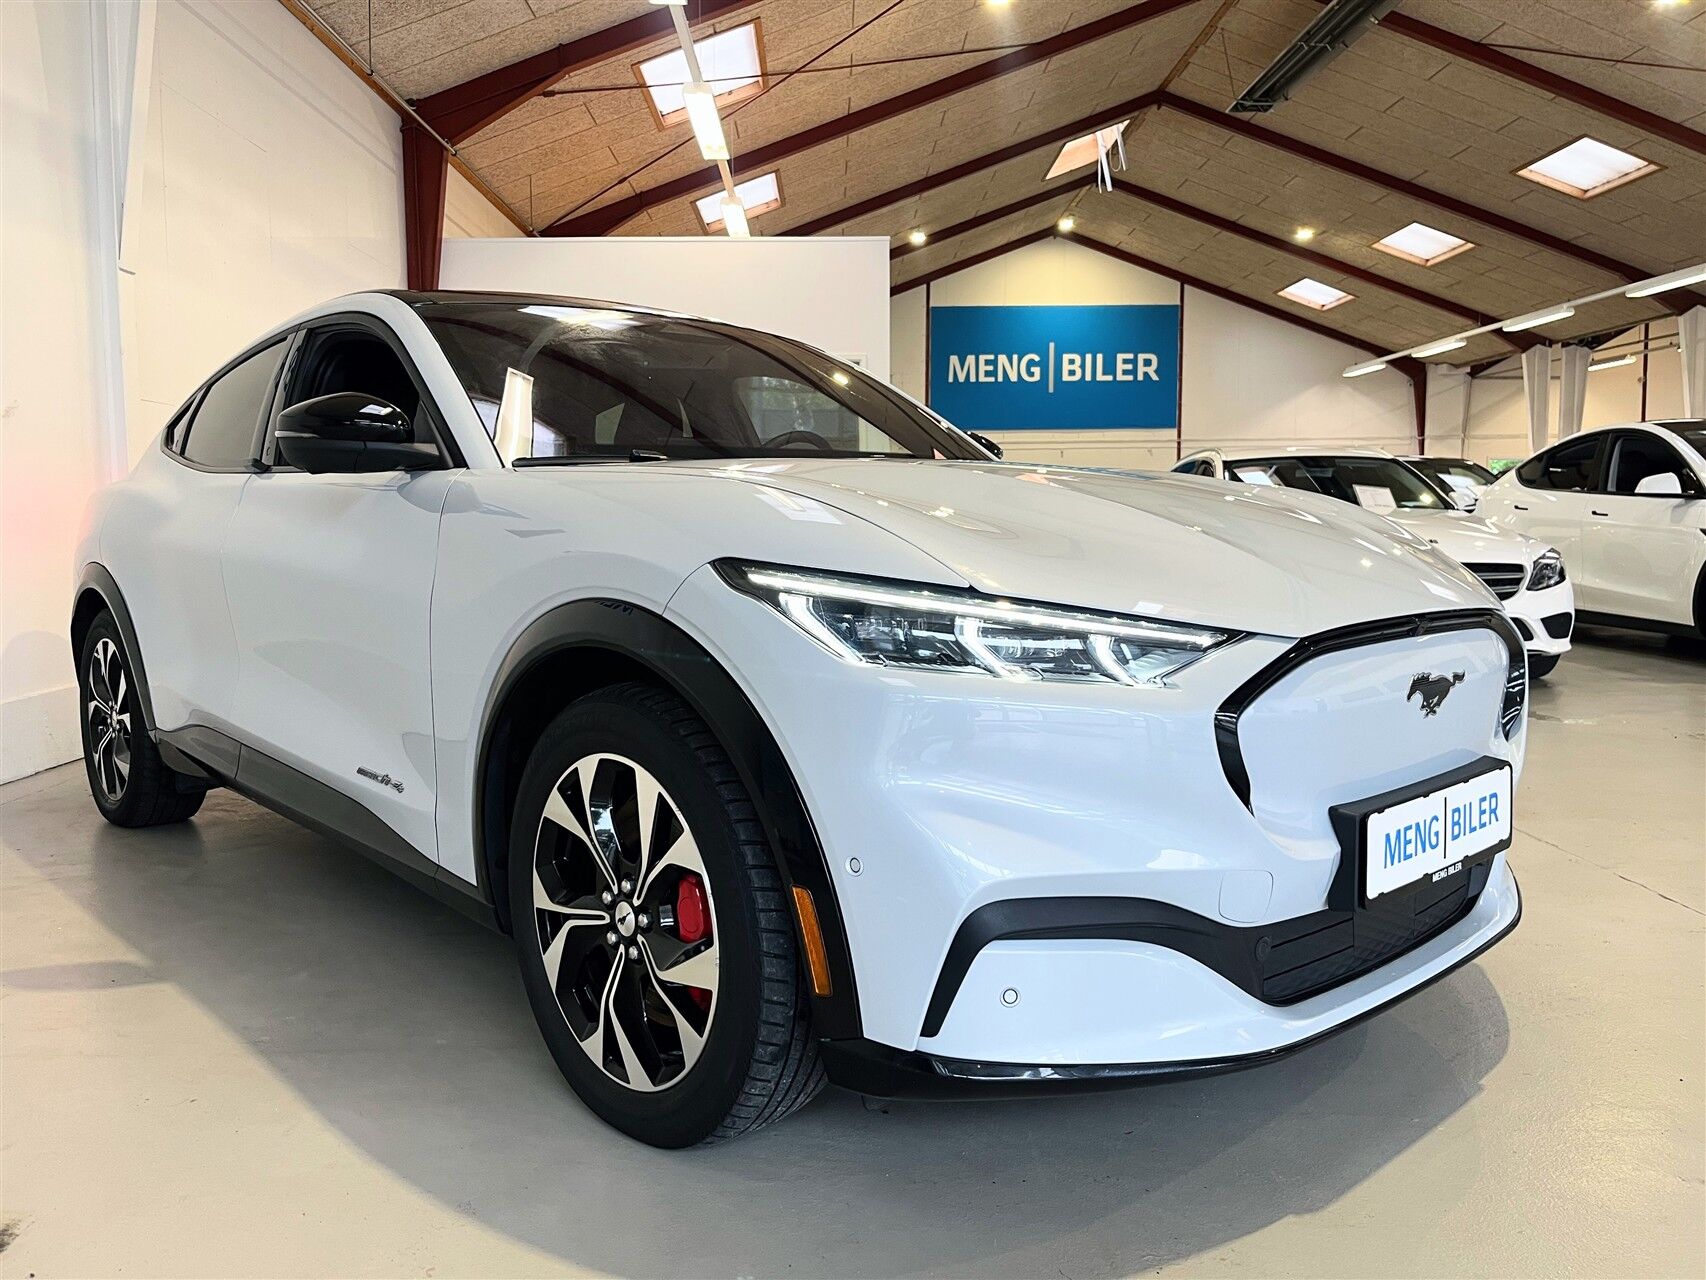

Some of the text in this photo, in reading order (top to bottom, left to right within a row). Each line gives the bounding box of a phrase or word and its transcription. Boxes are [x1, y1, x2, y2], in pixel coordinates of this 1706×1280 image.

[948, 353, 1160, 383] MENG BILER
[1384, 792, 1499, 869] MENG BILER
[1432, 862, 1462, 883] MENG BILER
